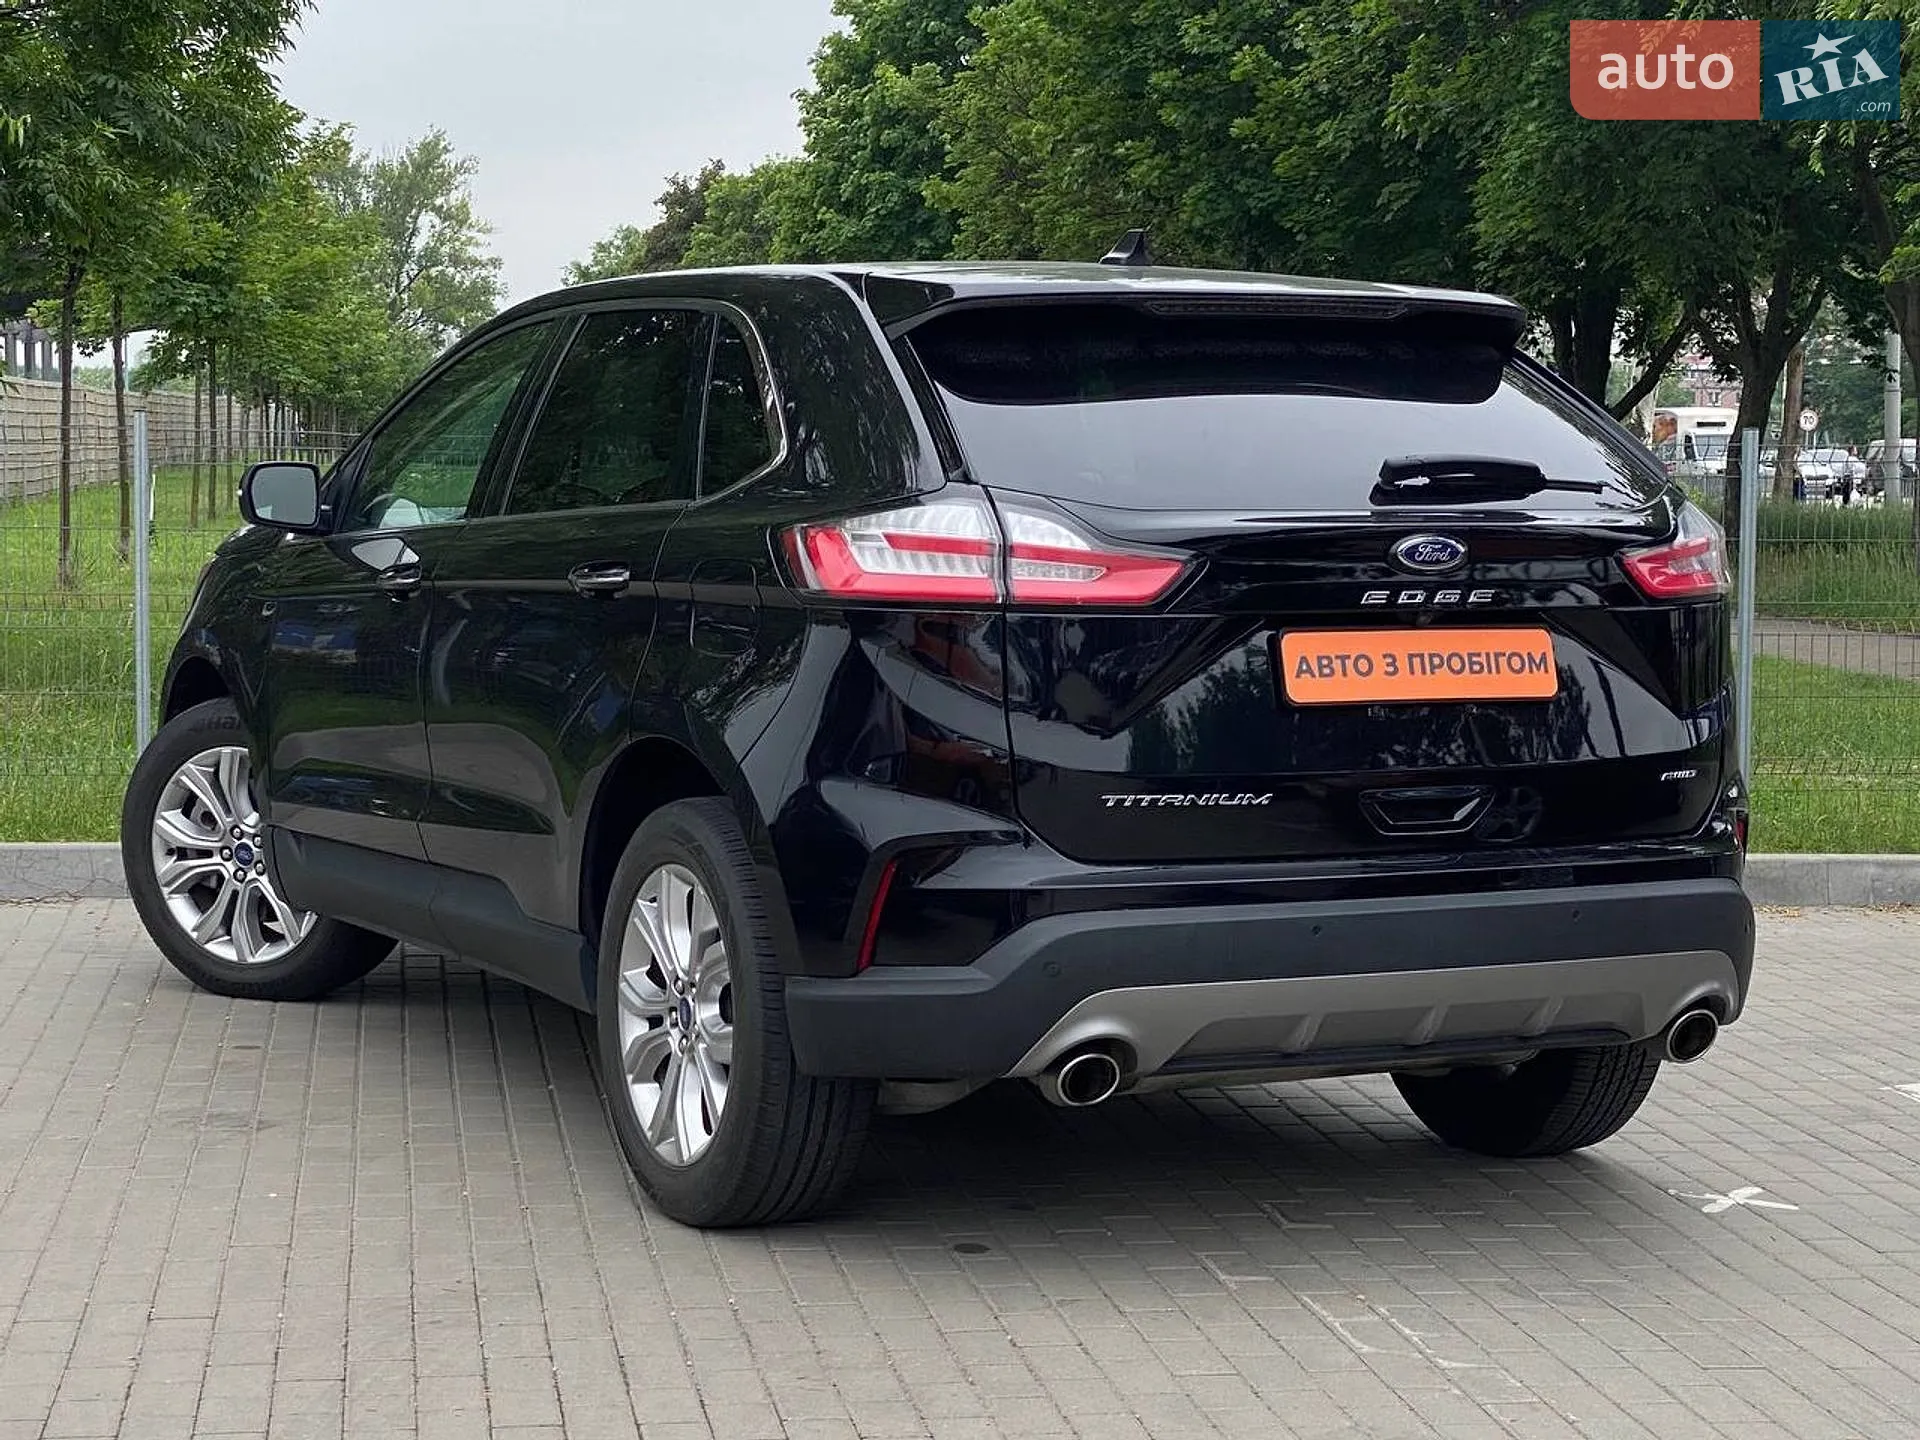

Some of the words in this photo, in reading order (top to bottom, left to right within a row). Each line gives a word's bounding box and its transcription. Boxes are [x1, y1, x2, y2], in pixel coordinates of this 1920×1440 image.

[1803, 415, 1815, 425] 70
[1414, 543, 1452, 561] Ford
[1360, 589, 1496, 605] EDGE
[1295, 653, 1375, 679] АВТО
[1406, 651, 1550, 676] ПРОБІГОМ
[1101, 793, 1274, 808] TITANIUM
